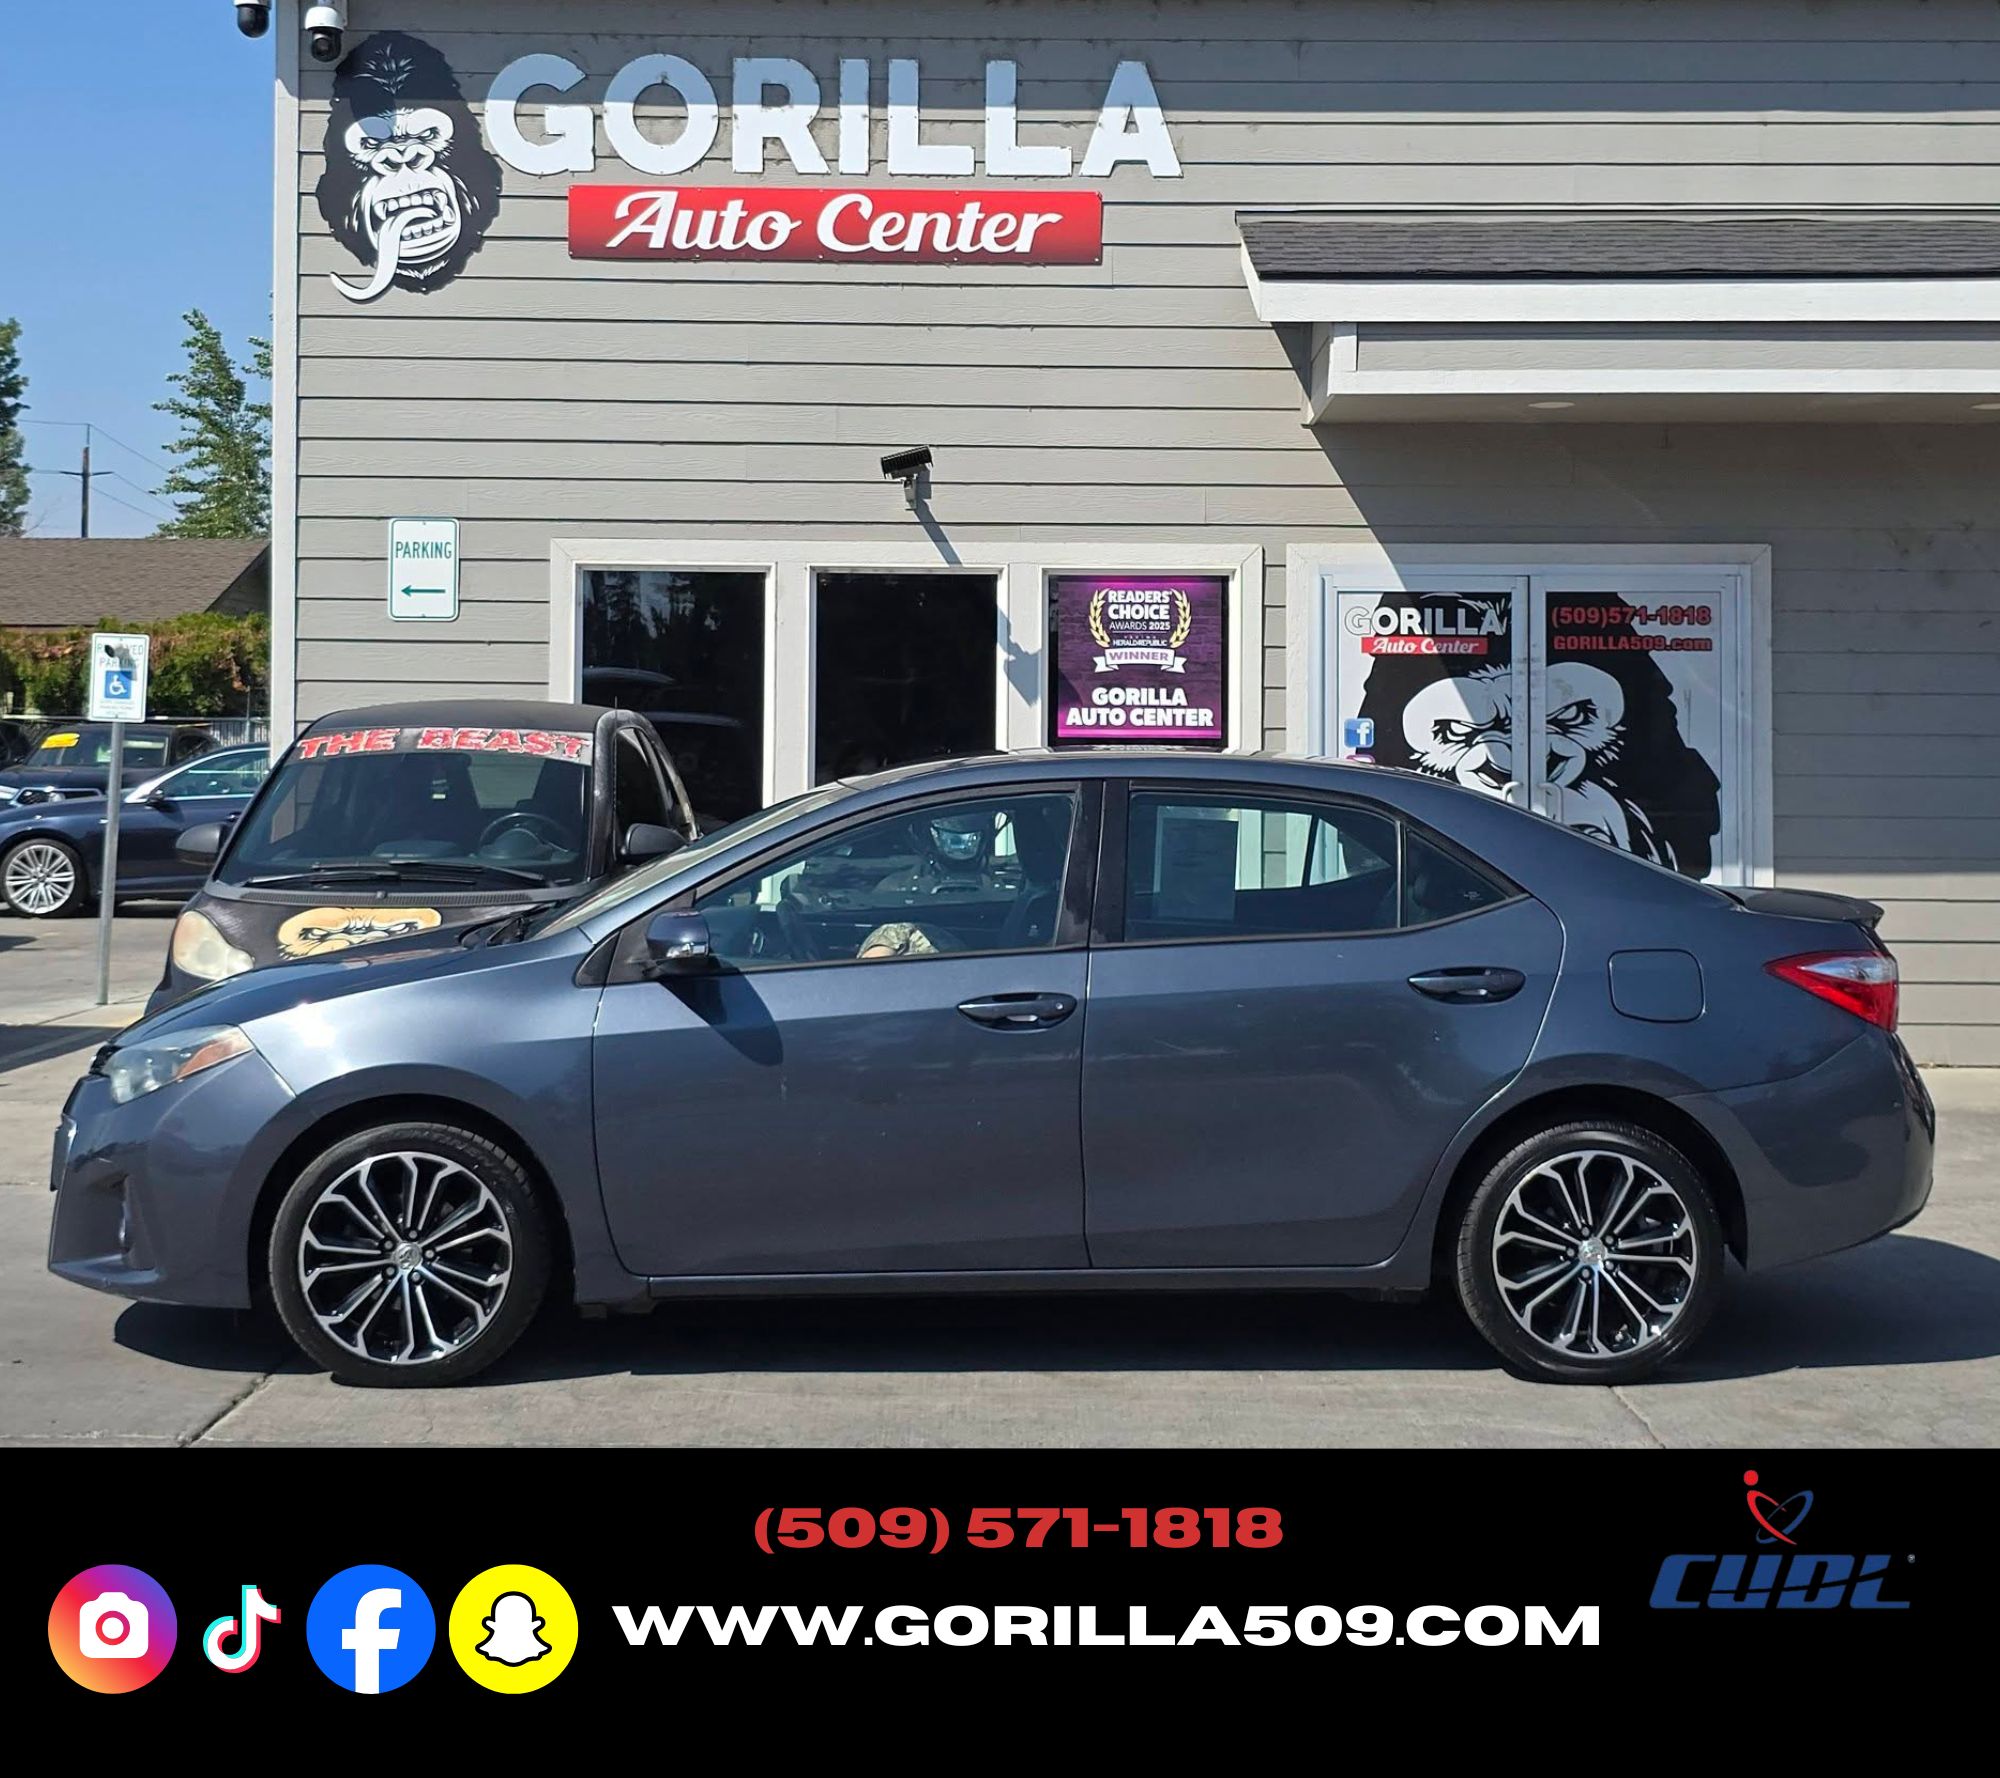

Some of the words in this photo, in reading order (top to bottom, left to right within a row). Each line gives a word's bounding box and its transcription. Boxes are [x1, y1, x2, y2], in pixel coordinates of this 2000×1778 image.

[485, 53, 1184, 178] GORILLA
[605, 190, 802, 251] Auto
[816, 193, 1063, 254] Center
[395, 541, 453, 560] PARKING
[1108, 604, 1170, 620] CHOICE
[1344, 606, 1504, 636] GORILLA
[1552, 605, 1712, 629] (509)571-1818
[1109, 621, 1147, 630] AWARDS
[1148, 621, 1171, 630] 2025
[1372, 637, 1417, 654] Auto
[1420, 637, 1479, 655] Center
[1553, 635, 1713, 651] GORILLA509.com
[1109, 651, 1169, 661] WINNER
[1091, 687, 1188, 706] GORILLA
[1065, 708, 1127, 726] AUTO
[1129, 708, 1214, 727] CENTER
[299, 728, 401, 760] THE
[416, 727, 592, 759] BEAST
